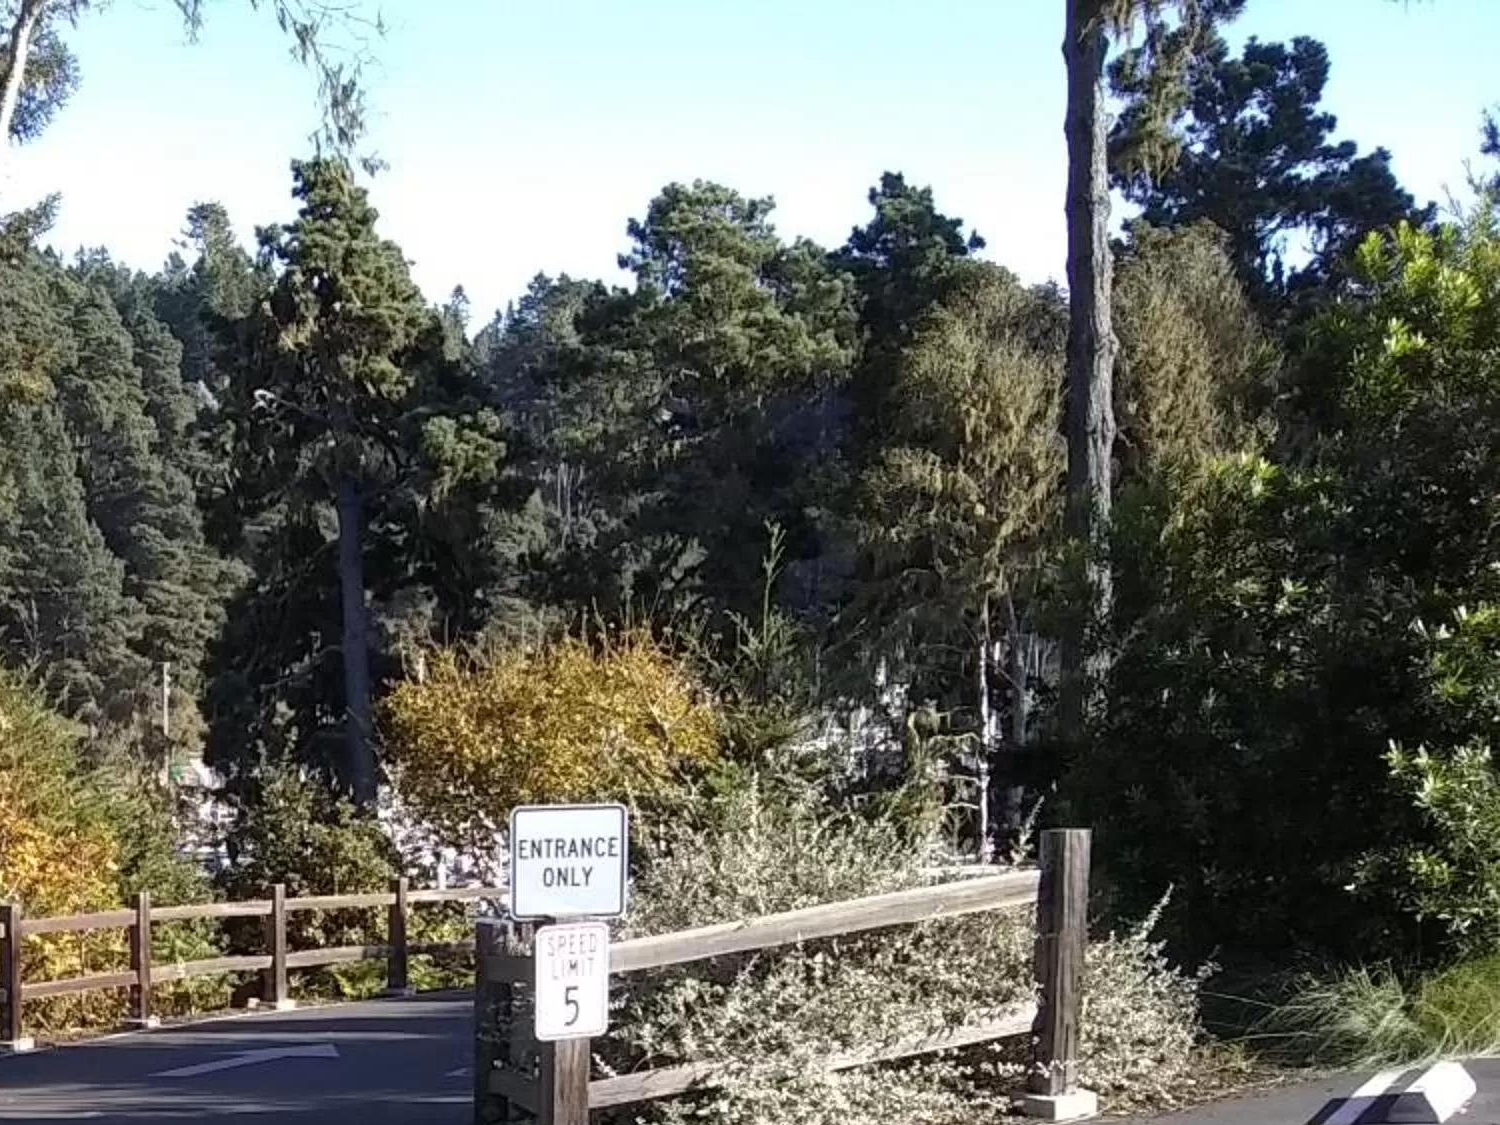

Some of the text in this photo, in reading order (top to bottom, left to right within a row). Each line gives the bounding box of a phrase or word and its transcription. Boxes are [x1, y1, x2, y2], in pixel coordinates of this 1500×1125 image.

[518, 837, 620, 860] ENTRANCE
[543, 867, 593, 888] ONLY
[547, 933, 597, 956] SPEED
[551, 957, 595, 980] LIMIT
[564, 986, 580, 1026] 5
